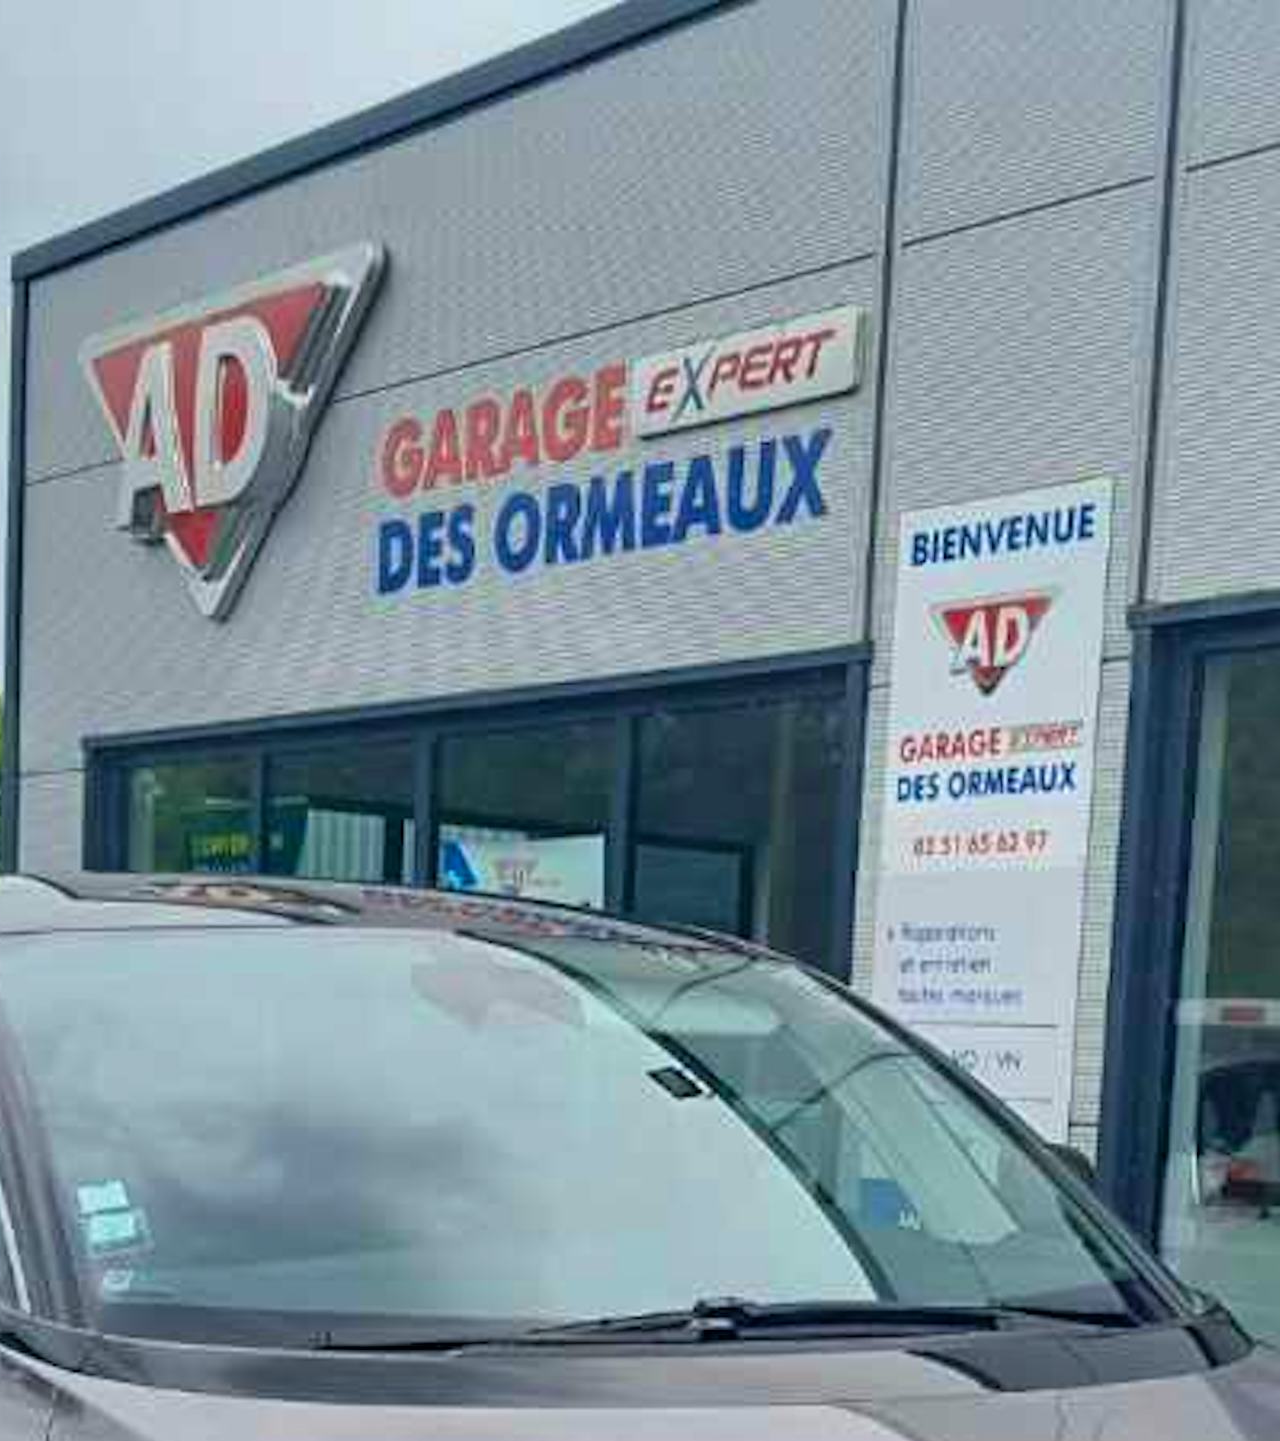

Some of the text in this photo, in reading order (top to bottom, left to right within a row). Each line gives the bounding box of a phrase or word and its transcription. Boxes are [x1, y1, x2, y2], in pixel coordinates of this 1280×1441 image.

[119, 314, 278, 533] AD
[382, 329, 835, 498] GARAGE EXPERT
[377, 429, 832, 594] DES ORMEAUX
[911, 504, 1095, 567] BIENVENUE
[950, 605, 1031, 676] AD
[899, 728, 1001, 763] GARAGE
[897, 762, 1076, 801] DES ORMEAUX
